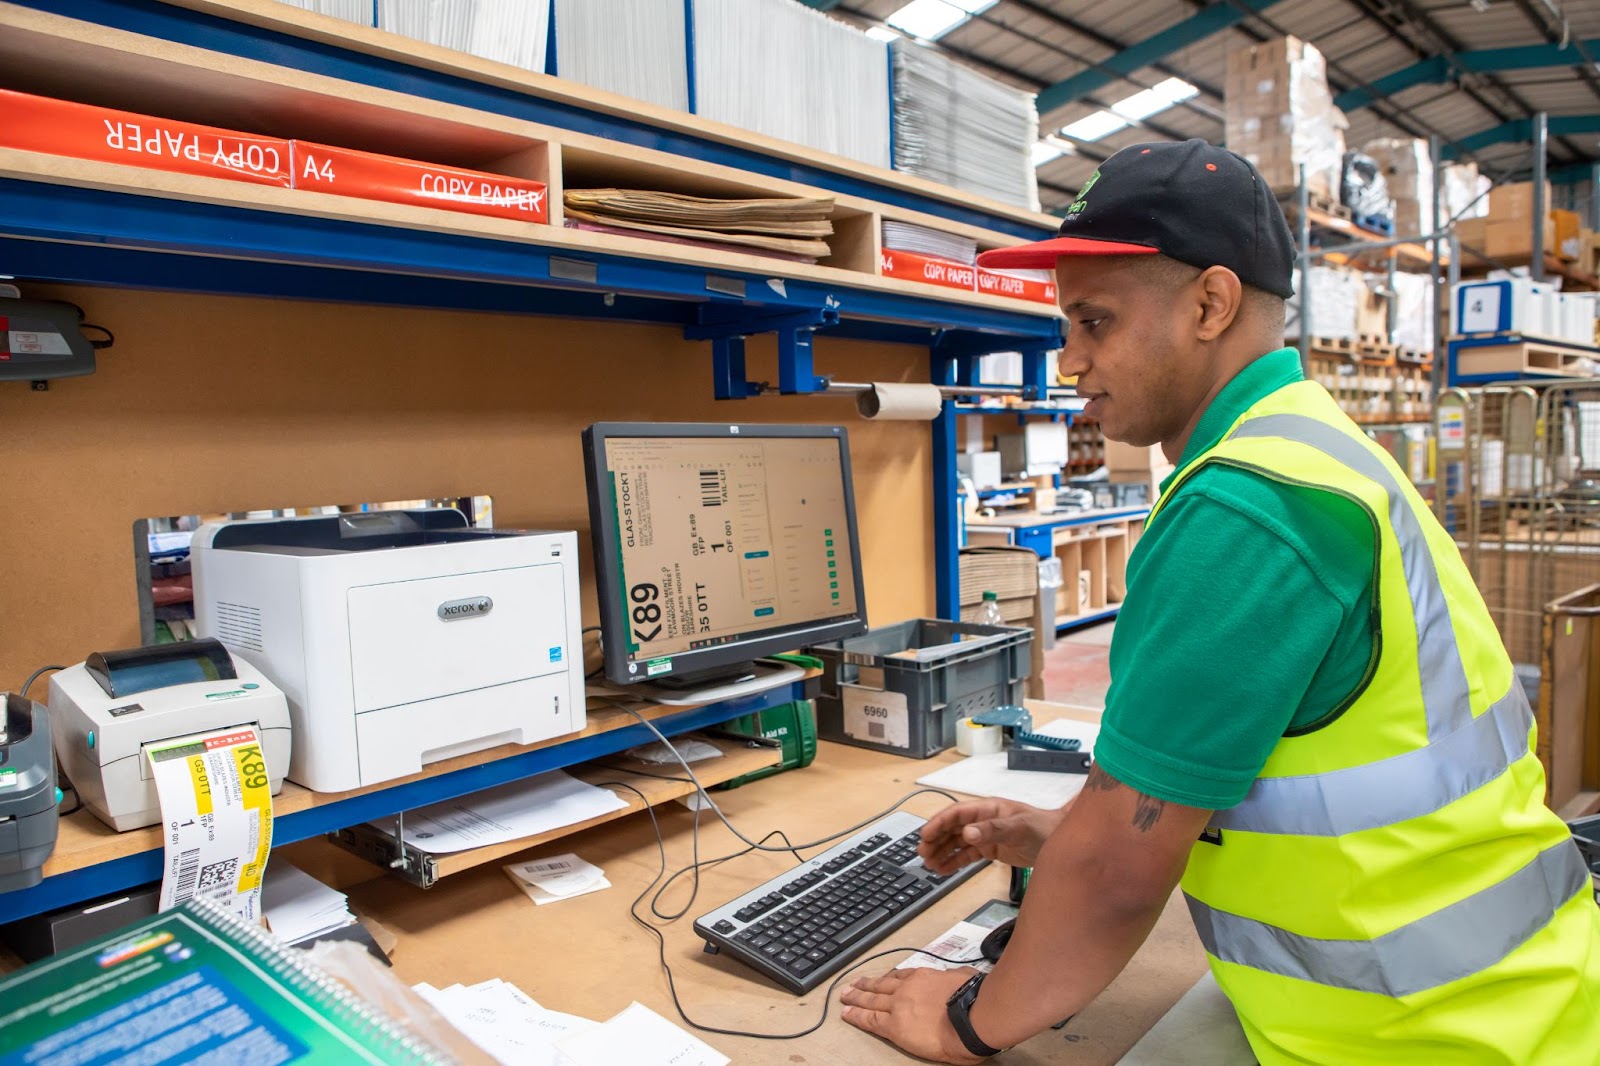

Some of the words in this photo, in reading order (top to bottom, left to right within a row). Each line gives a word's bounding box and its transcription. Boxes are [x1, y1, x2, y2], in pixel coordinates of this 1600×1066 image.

[103, 119, 200, 161] PAPER
[212, 138, 280, 174] COPY
[303, 155, 336, 183] A4
[420, 173, 473, 203] COPY
[480, 184, 541, 214] PAPER
[881, 256, 894, 272] A4
[923, 263, 946, 281] COPY
[947, 268, 973, 285] PAPER
[979, 274, 1000, 290] COPY
[1000, 278, 1024, 294] PAPER
[1044, 287, 1055, 299] A4
[620, 471, 635, 548] GLA3-STOCKT
[724, 520, 732, 537] 001
[692, 542, 699, 556] GB
[698, 536, 706, 554] 1FP
[710, 543, 725, 553] 1
[726, 538, 734, 553] OF
[444, 602, 475, 616] xerox
[863, 705, 888, 719] 6960
[765, 729, 777, 738] Aid
[777, 726, 788, 736] Kit
[194, 759, 206, 774] G5
[237, 745, 268, 789] K89
[198, 775, 211, 796] 0TT
[180, 818, 196, 828] 1
[207, 813, 214, 823] GB
[171, 821, 178, 832] OF
[171, 834, 179, 845] 001
